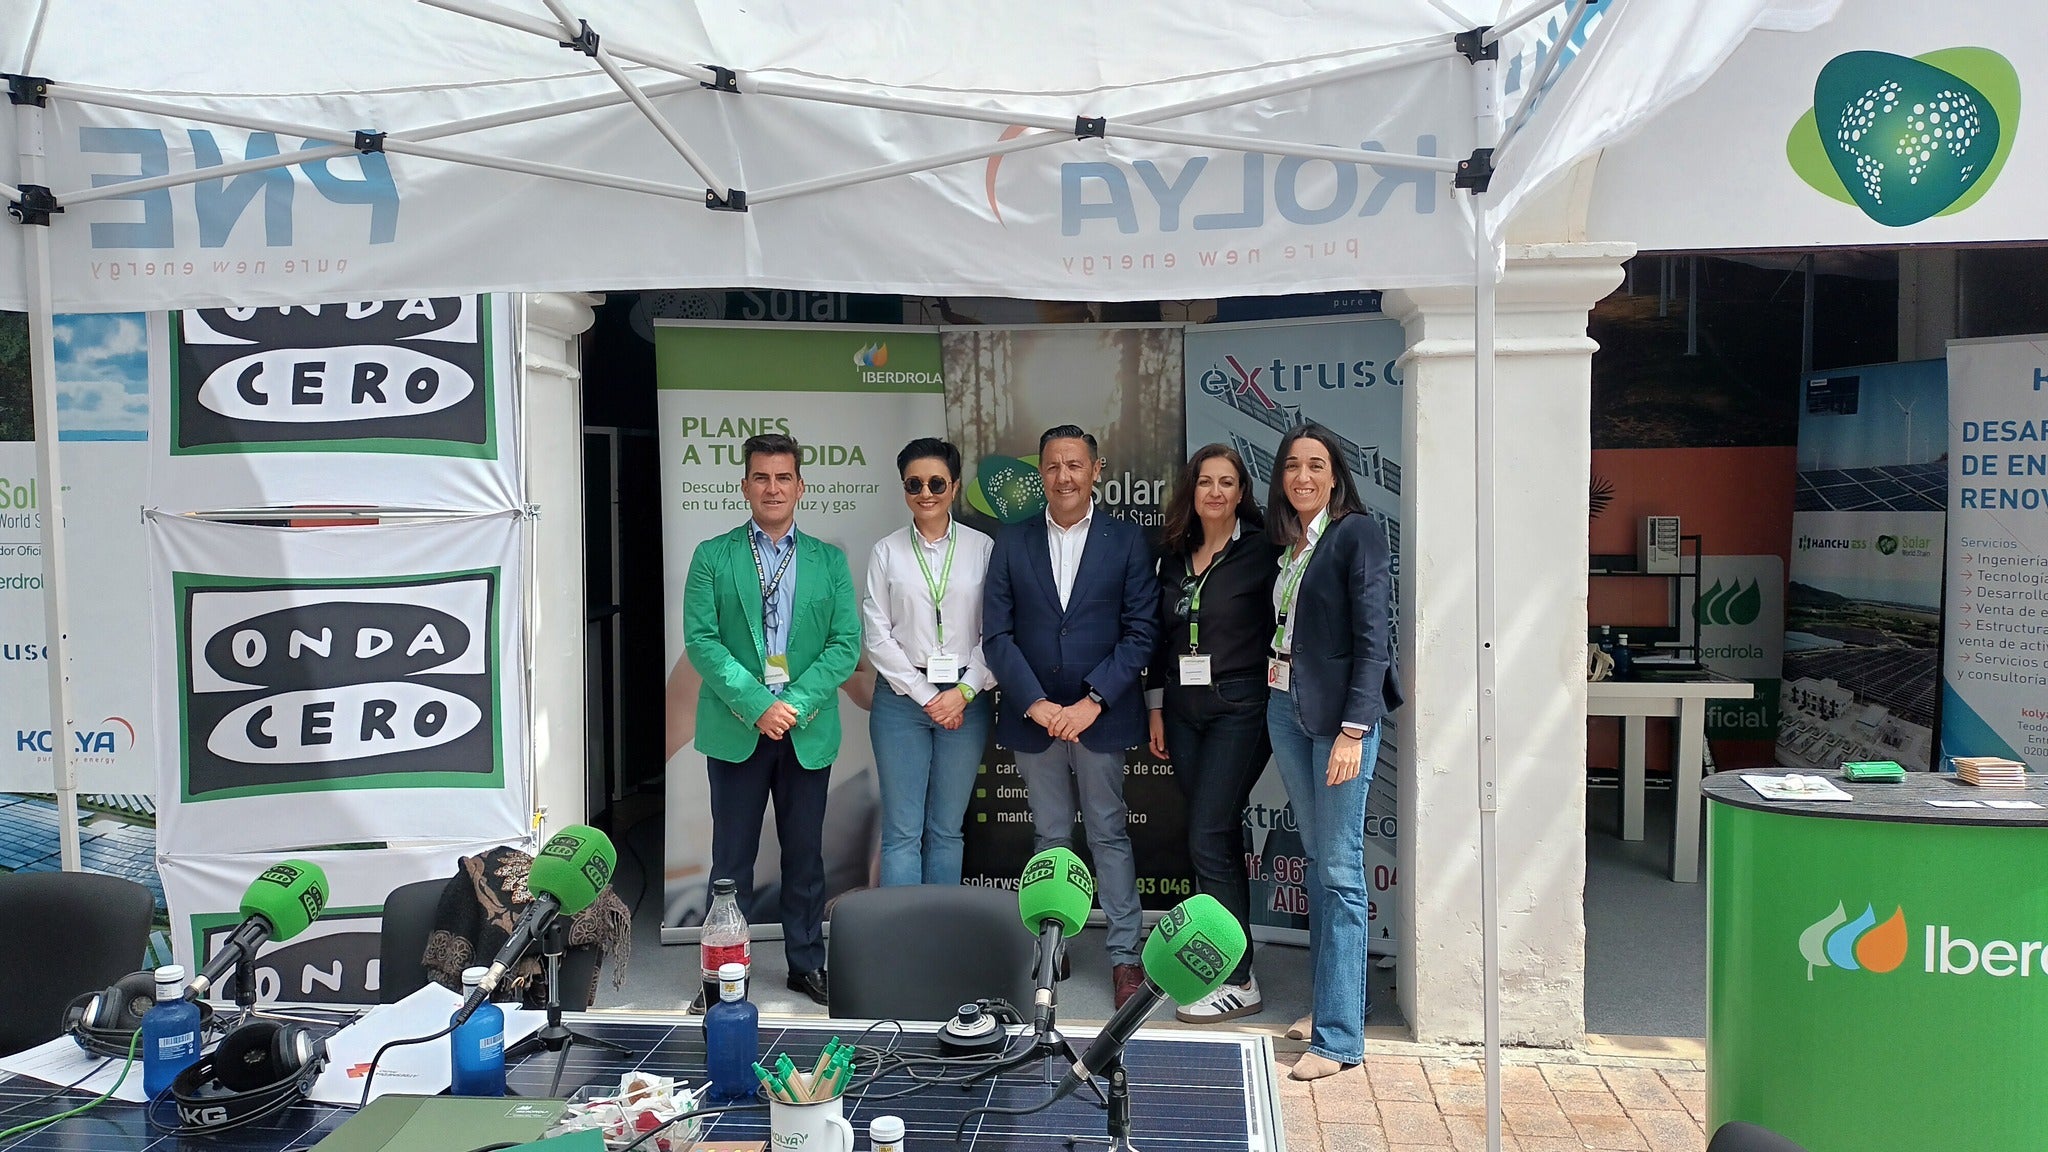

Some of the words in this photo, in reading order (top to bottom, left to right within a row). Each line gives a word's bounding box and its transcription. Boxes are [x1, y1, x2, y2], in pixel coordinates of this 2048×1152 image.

[236, 361, 440, 406] CERO
[862, 371, 943, 385] IBERDROLA
[682, 417, 790, 438] PLANES
[682, 445, 701, 466] A
[708, 445, 745, 466] TU
[800, 445, 866, 466] DIDA
[1962, 455, 1998, 476] DE
[2008, 455, 2046, 476] EN
[682, 481, 743, 494] Descubr
[829, 481, 880, 494] ahorrar
[1092, 472, 1166, 505] Solar
[682, 501, 698, 511] en
[704, 500, 718, 511] tu
[722, 498, 751, 511] fact
[821, 503, 829, 514] y
[833, 503, 857, 514] gas
[17, 545, 41, 556] Ofici
[1902, 536, 1930, 549] Solar
[1961, 537, 2018, 549] Servicios
[1978, 553, 2048, 568] Ingeniería
[0, 573, 44, 590] erdrol
[1976, 603, 2014, 615] Venta
[2019, 606, 2036, 618] de
[231, 623, 445, 668] ONDA
[1958, 637, 1994, 648] venta
[1999, 639, 2015, 650] de
[1975, 653, 2038, 668] Servicios
[1957, 670, 1964, 680] y
[1968, 671, 2047, 686] consultoria
[246, 700, 448, 749] CERO
[1707, 706, 1768, 727] ficial
[17, 730, 115, 753] KOYA
[1133, 761, 1148, 775] de
[1273, 855, 1308, 885] 96
[1160, 878, 1190, 895] 046
[1187, 953, 1213, 976] CERO
